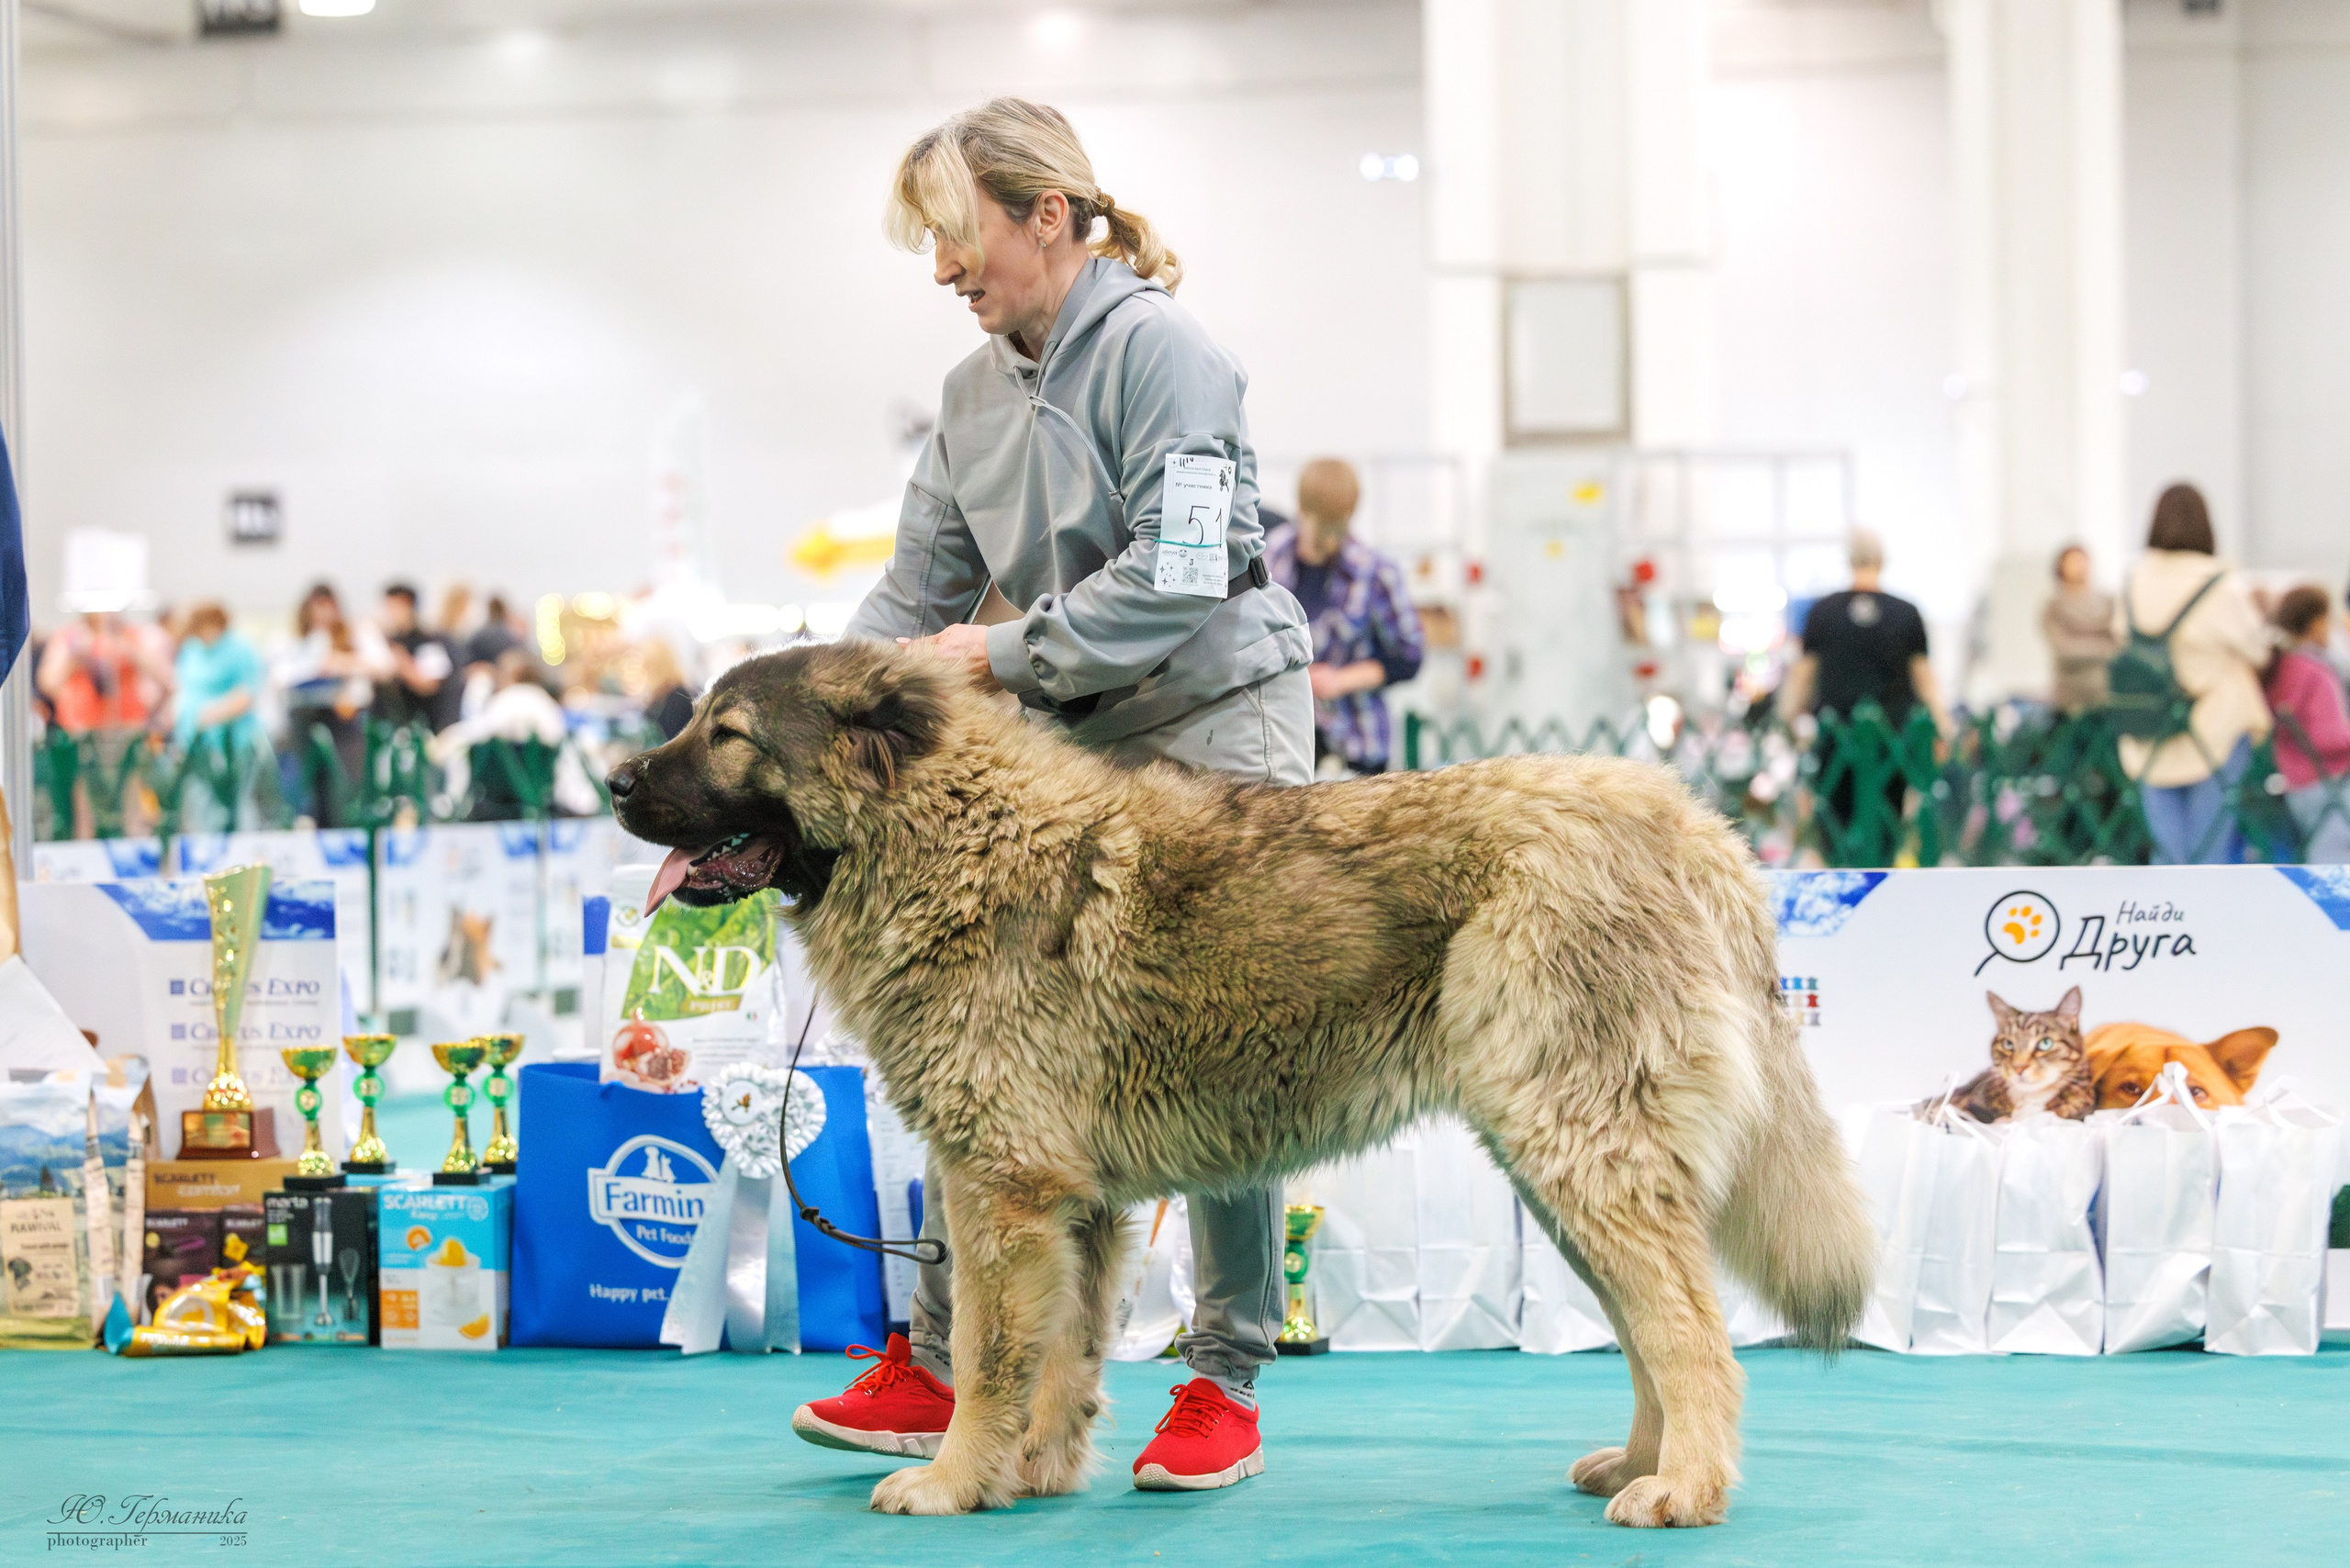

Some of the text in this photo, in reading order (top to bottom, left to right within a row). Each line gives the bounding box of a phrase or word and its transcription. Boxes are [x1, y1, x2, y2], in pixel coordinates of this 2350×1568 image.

[1181, 505, 1223, 548] 51
[2116, 900, 2186, 924] Найди
[2059, 915, 2197, 972] Друга
[648, 944, 762, 997] N&D
[383, 1193, 466, 1210] SCARLETT
[605, 1182, 704, 1218] Farmin
[636, 1224, 658, 1242] Pet
[589, 1283, 639, 1303] Happy
